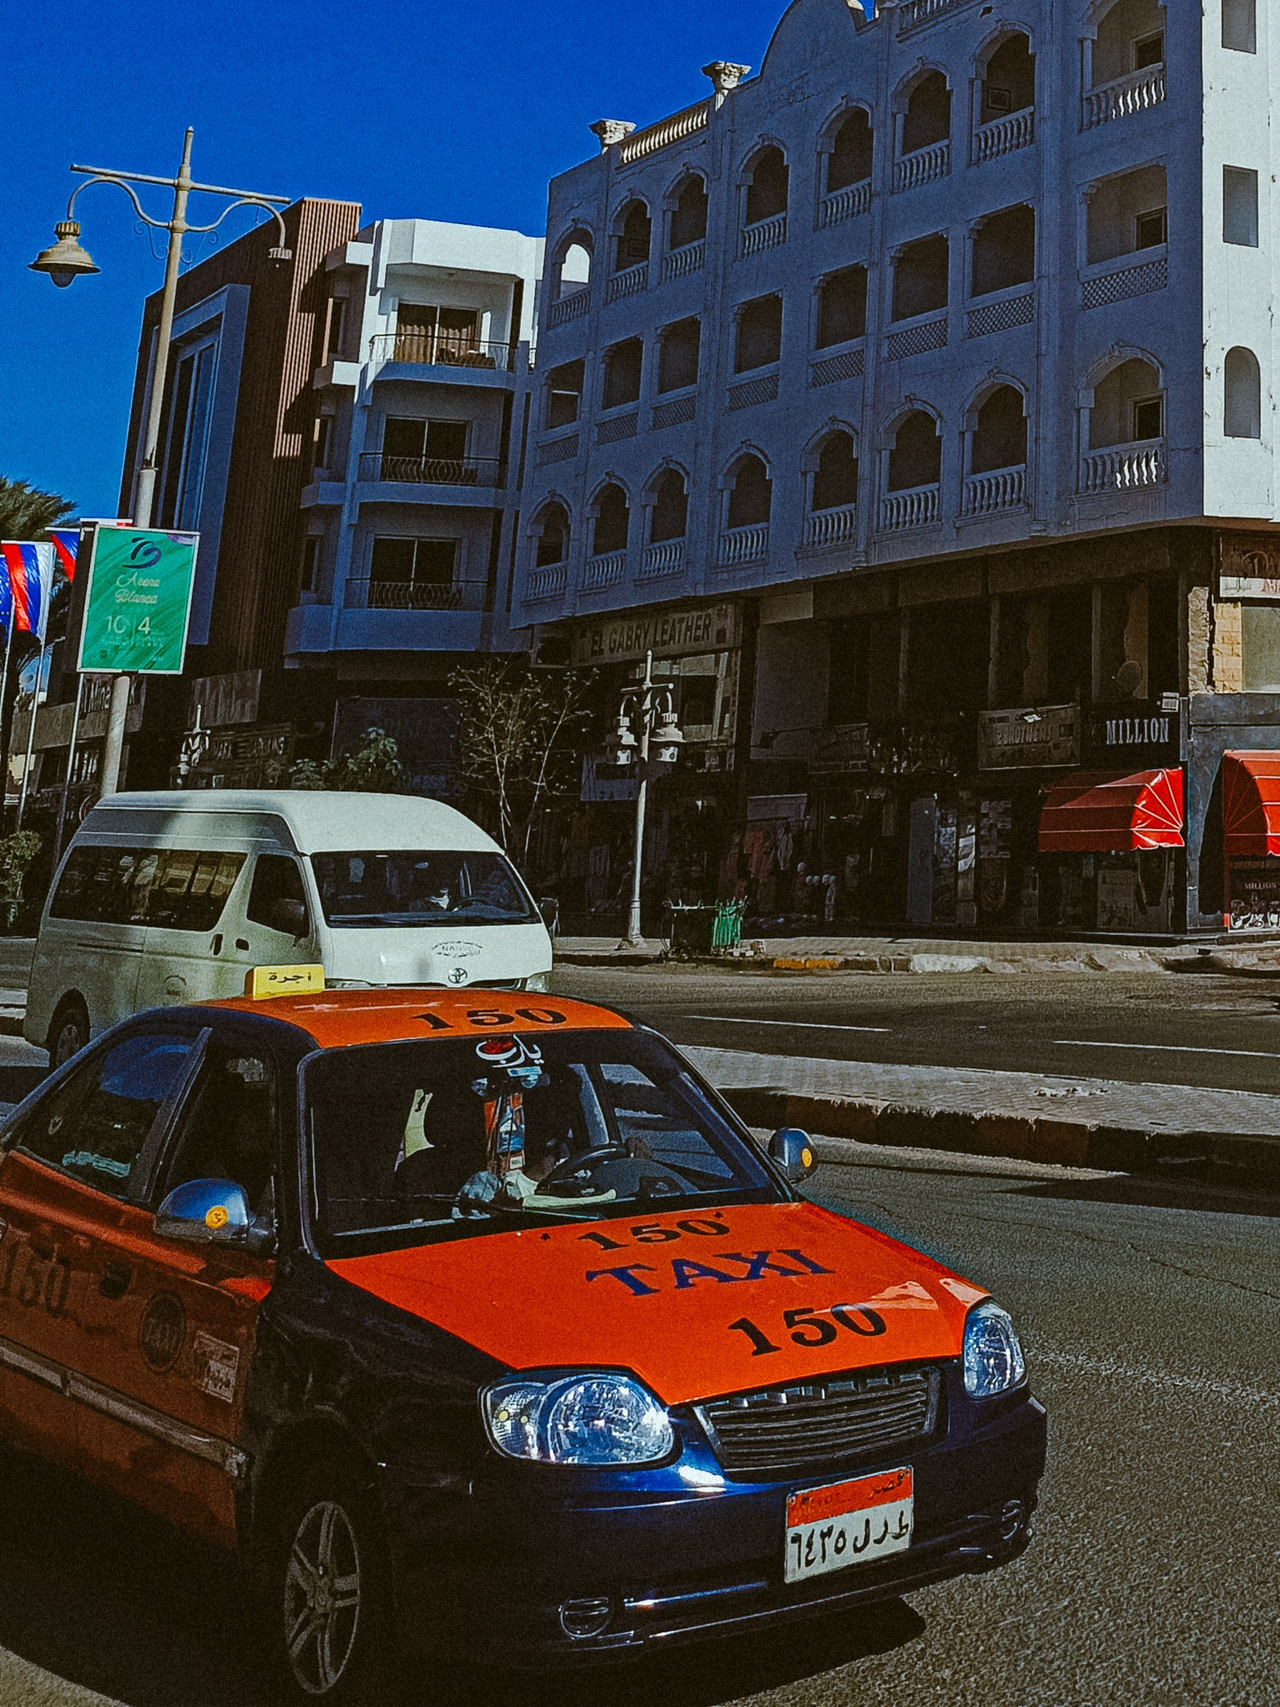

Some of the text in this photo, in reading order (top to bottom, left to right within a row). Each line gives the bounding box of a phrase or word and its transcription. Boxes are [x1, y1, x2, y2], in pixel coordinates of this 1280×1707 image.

[116, 572, 160, 588] Arena
[114, 588, 159, 605] Blanca
[590, 612, 712, 657] EL GABRY LEATHER
[1105, 717, 1170, 745] MILLION
[1244, 881, 1277, 890] MILLION
[410, 1007, 568, 1031] 150
[577, 1219, 731, 1251] 150
[585, 1249, 837, 1297] TAXI
[727, 1302, 888, 1357] 150
